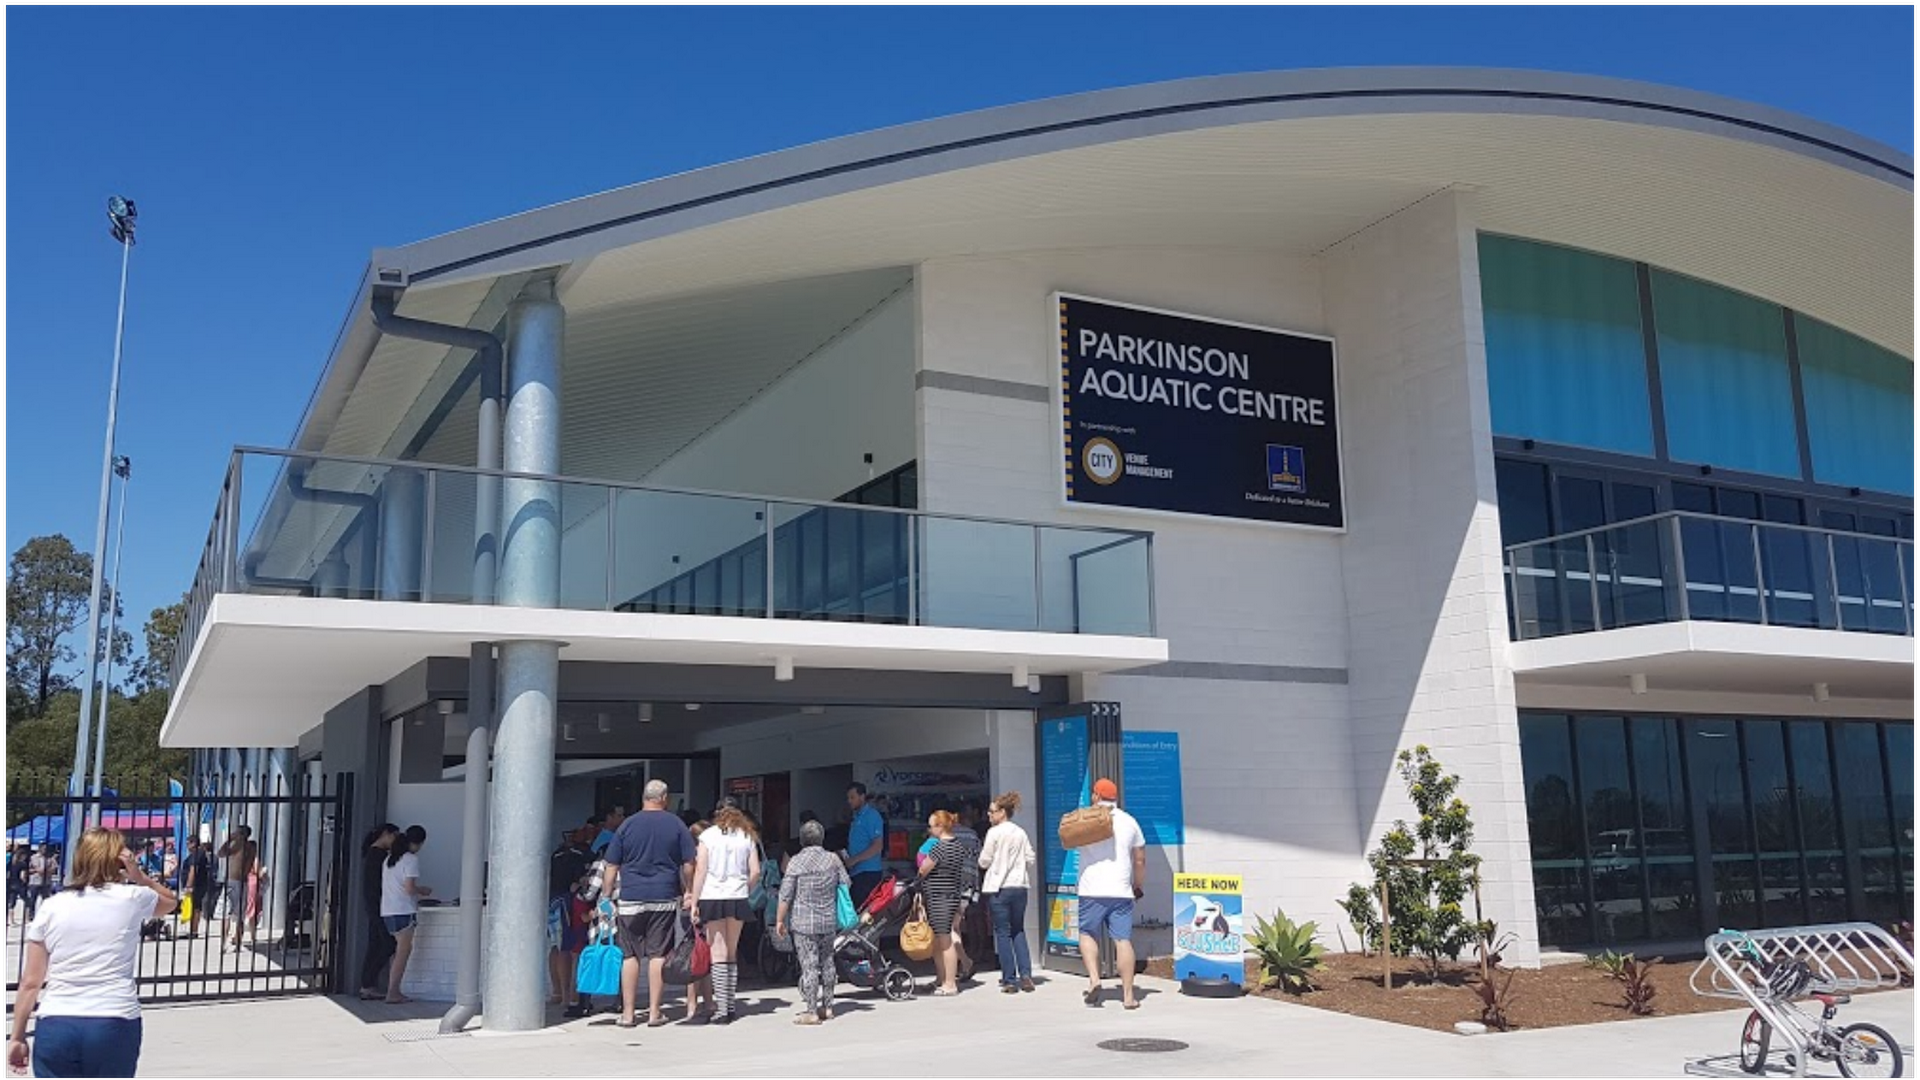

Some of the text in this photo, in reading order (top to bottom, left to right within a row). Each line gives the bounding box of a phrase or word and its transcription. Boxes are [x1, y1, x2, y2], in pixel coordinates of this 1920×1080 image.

[1080, 328, 1249, 380] PARKINSON
[1080, 367, 1326, 426] AQUATIC CENTRE
[1091, 452, 1114, 469] CITY
[1124, 453, 1149, 465] VENUE
[1125, 465, 1174, 480] MANAGEMENT
[1160, 741, 1177, 752] Entry
[1177, 878, 1239, 891] HERE NOW
